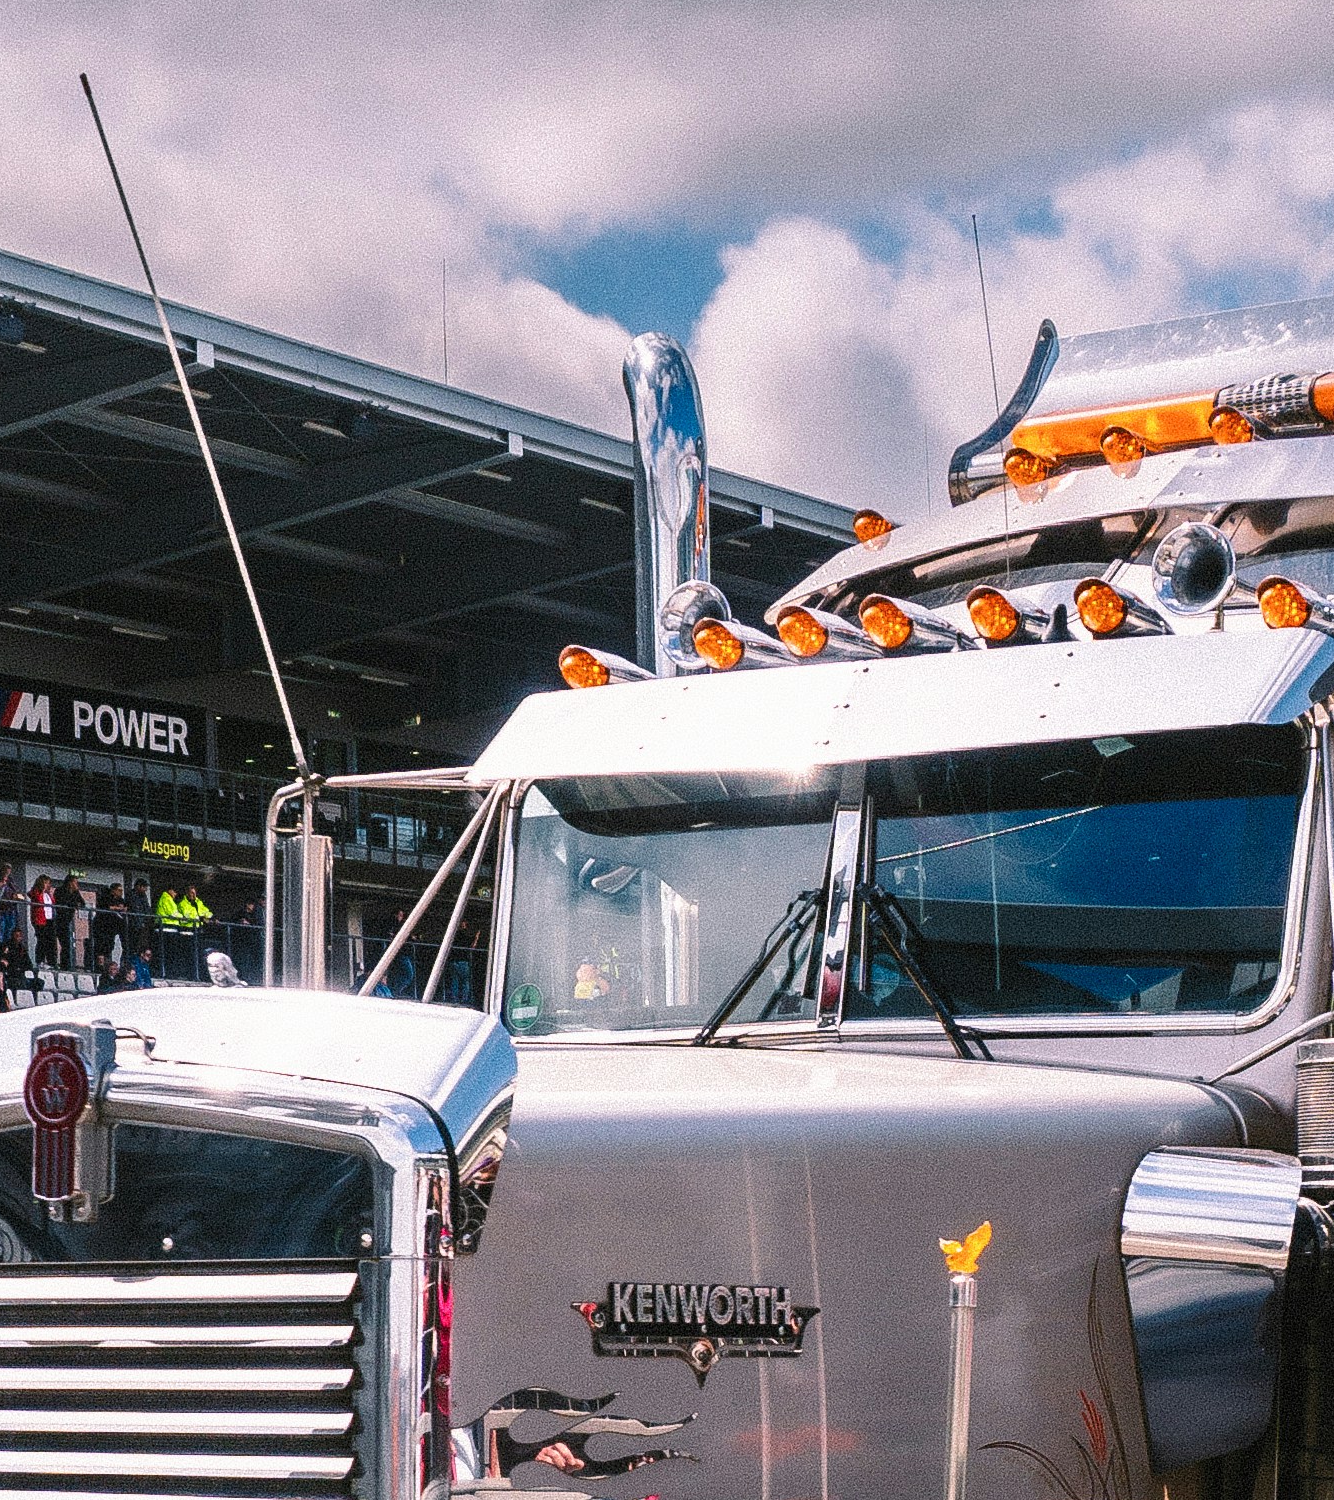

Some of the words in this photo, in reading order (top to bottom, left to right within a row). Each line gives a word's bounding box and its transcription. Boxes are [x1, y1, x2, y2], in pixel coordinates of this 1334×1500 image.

[73, 700, 189, 756] POWER
[142, 837, 190, 862] Ausgang
[613, 1283, 793, 1325] KENWORTH
